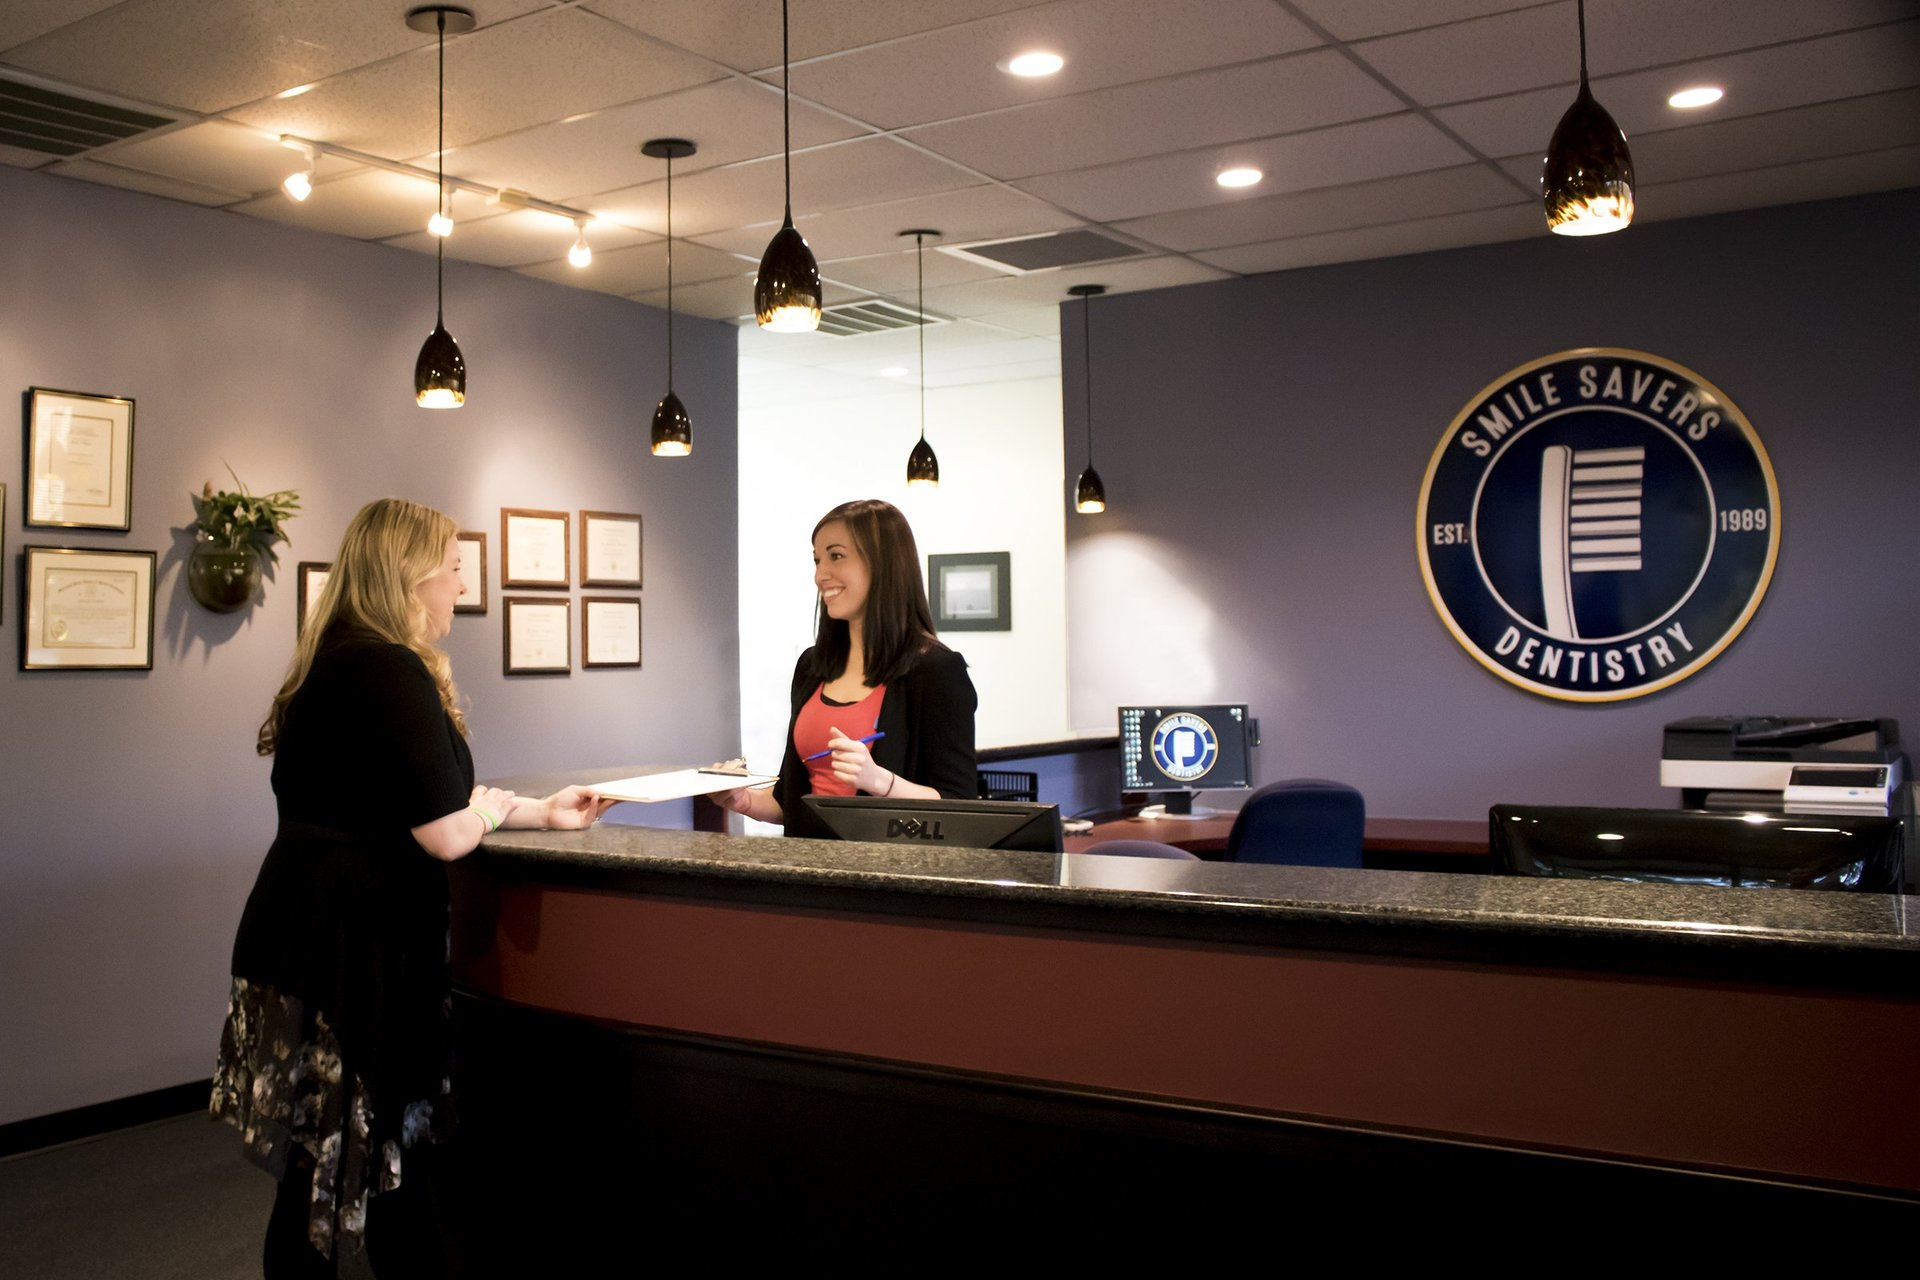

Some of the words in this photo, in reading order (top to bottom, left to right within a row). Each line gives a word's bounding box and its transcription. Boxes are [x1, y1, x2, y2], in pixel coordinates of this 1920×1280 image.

[1461, 373, 1561, 457] SMILE
[1579, 365, 1721, 441] SAVERS
[1433, 523, 1468, 545] EST.
[1720, 508, 1767, 531] 1989
[1495, 622, 1694, 683] DENTISTRY
[887, 817, 944, 839] DELL
